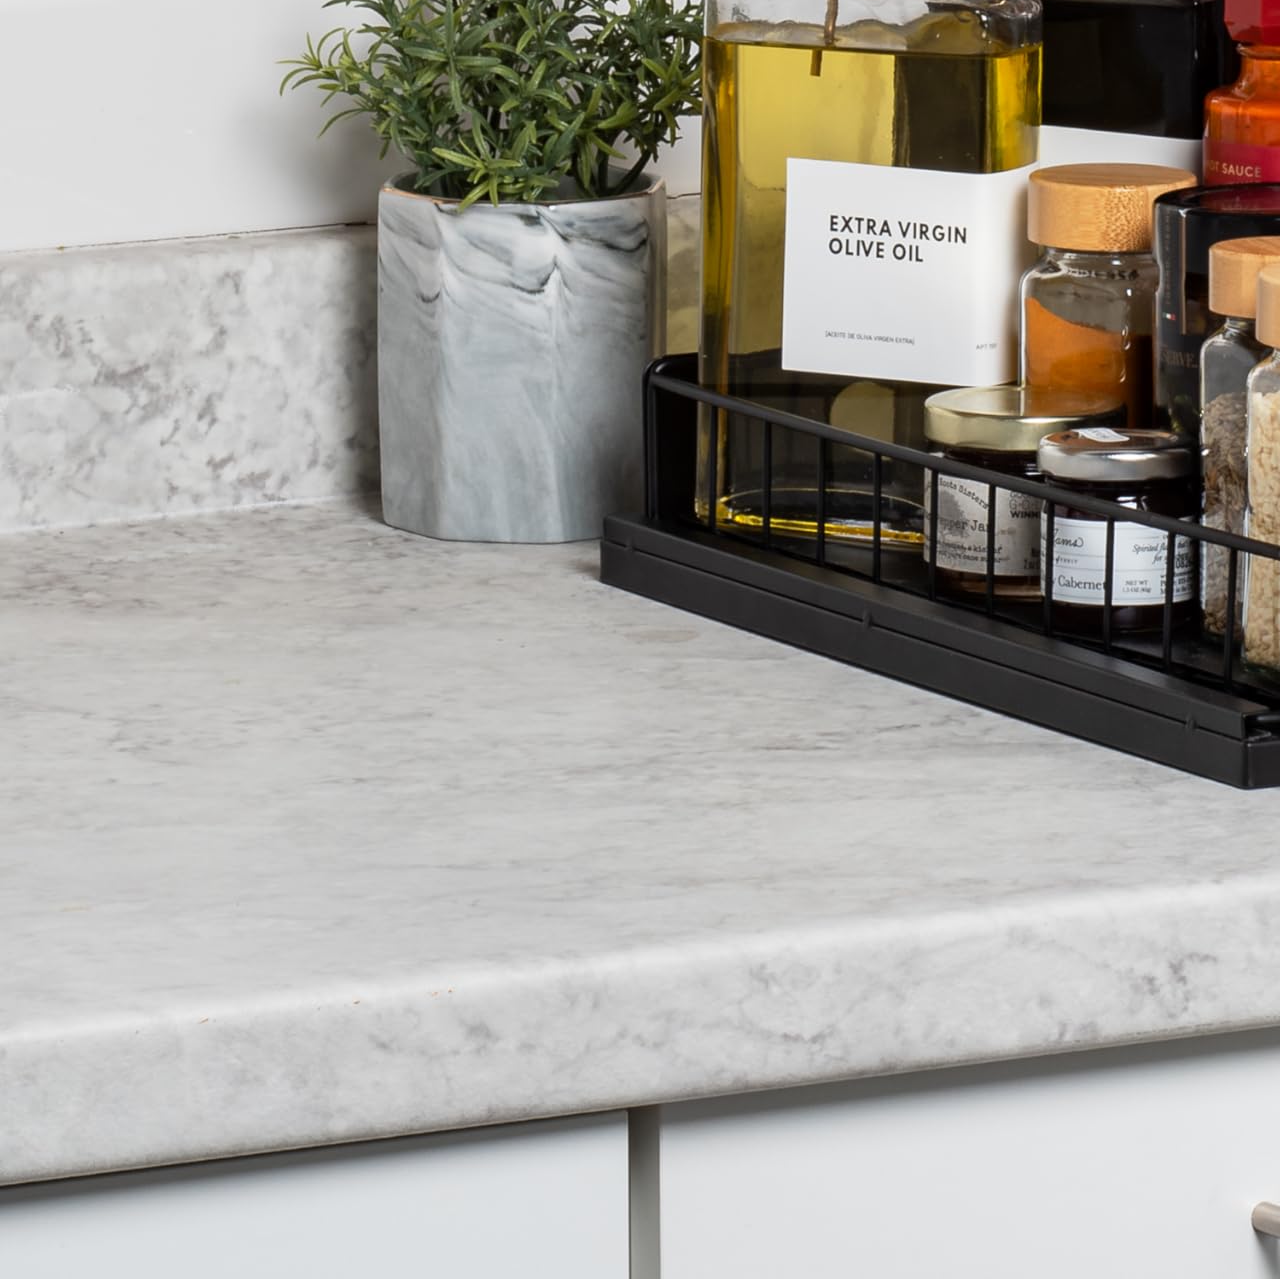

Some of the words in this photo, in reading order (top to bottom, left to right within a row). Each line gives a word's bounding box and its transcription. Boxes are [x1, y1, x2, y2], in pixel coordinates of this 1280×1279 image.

[1221, 162, 1262, 179] SAUCE
[829, 214, 892, 237] EXTRA
[897, 220, 967, 244] VIRGIN
[828, 237, 885, 259] OLIVE
[892, 243, 924, 263] OIL
[847, 332, 855, 340] DE
[958, 484, 989, 510] Sisters
[970, 519, 989, 533] Ja
